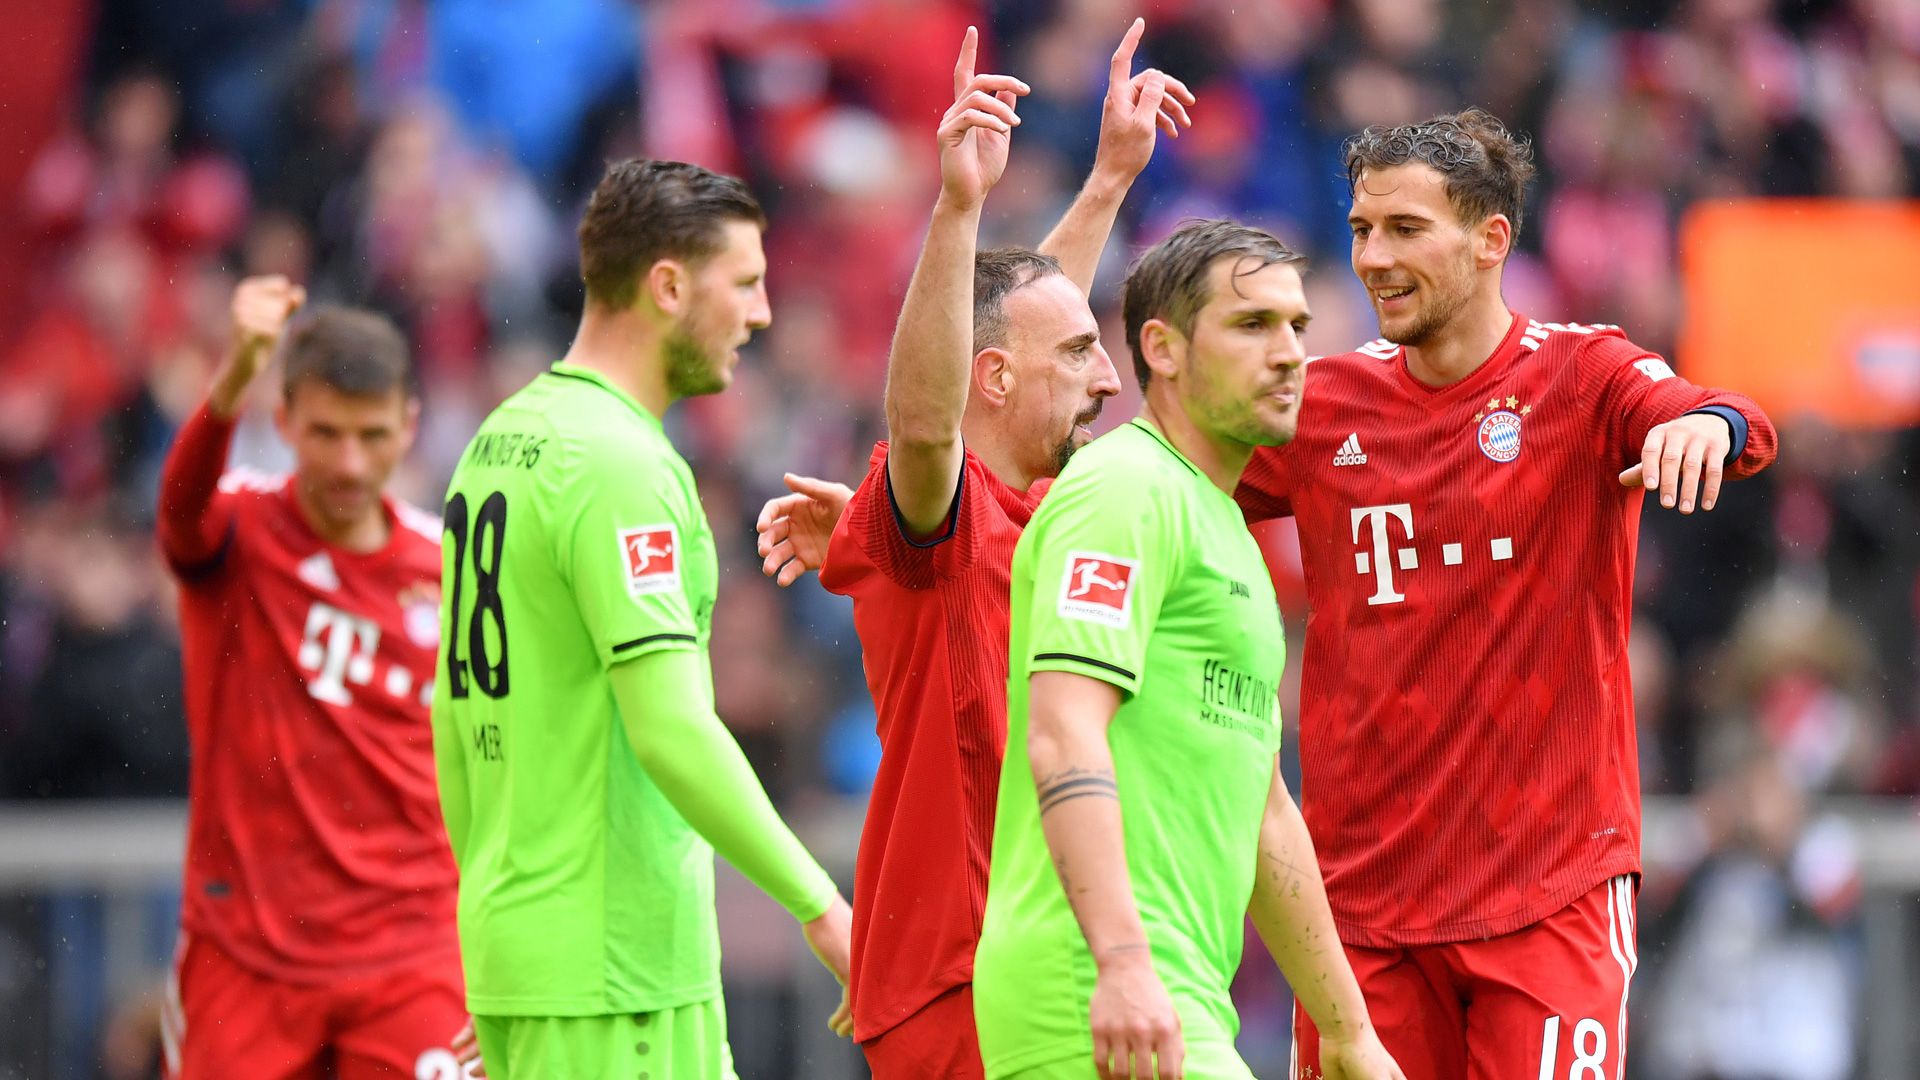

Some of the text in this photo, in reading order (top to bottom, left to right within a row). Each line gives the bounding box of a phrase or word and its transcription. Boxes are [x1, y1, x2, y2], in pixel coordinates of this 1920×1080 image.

[1482, 423, 1492, 435] FC
[516, 435, 548, 470] 96
[1333, 453, 1367, 467] adidas
[1538, 1015, 1608, 1080] 18
